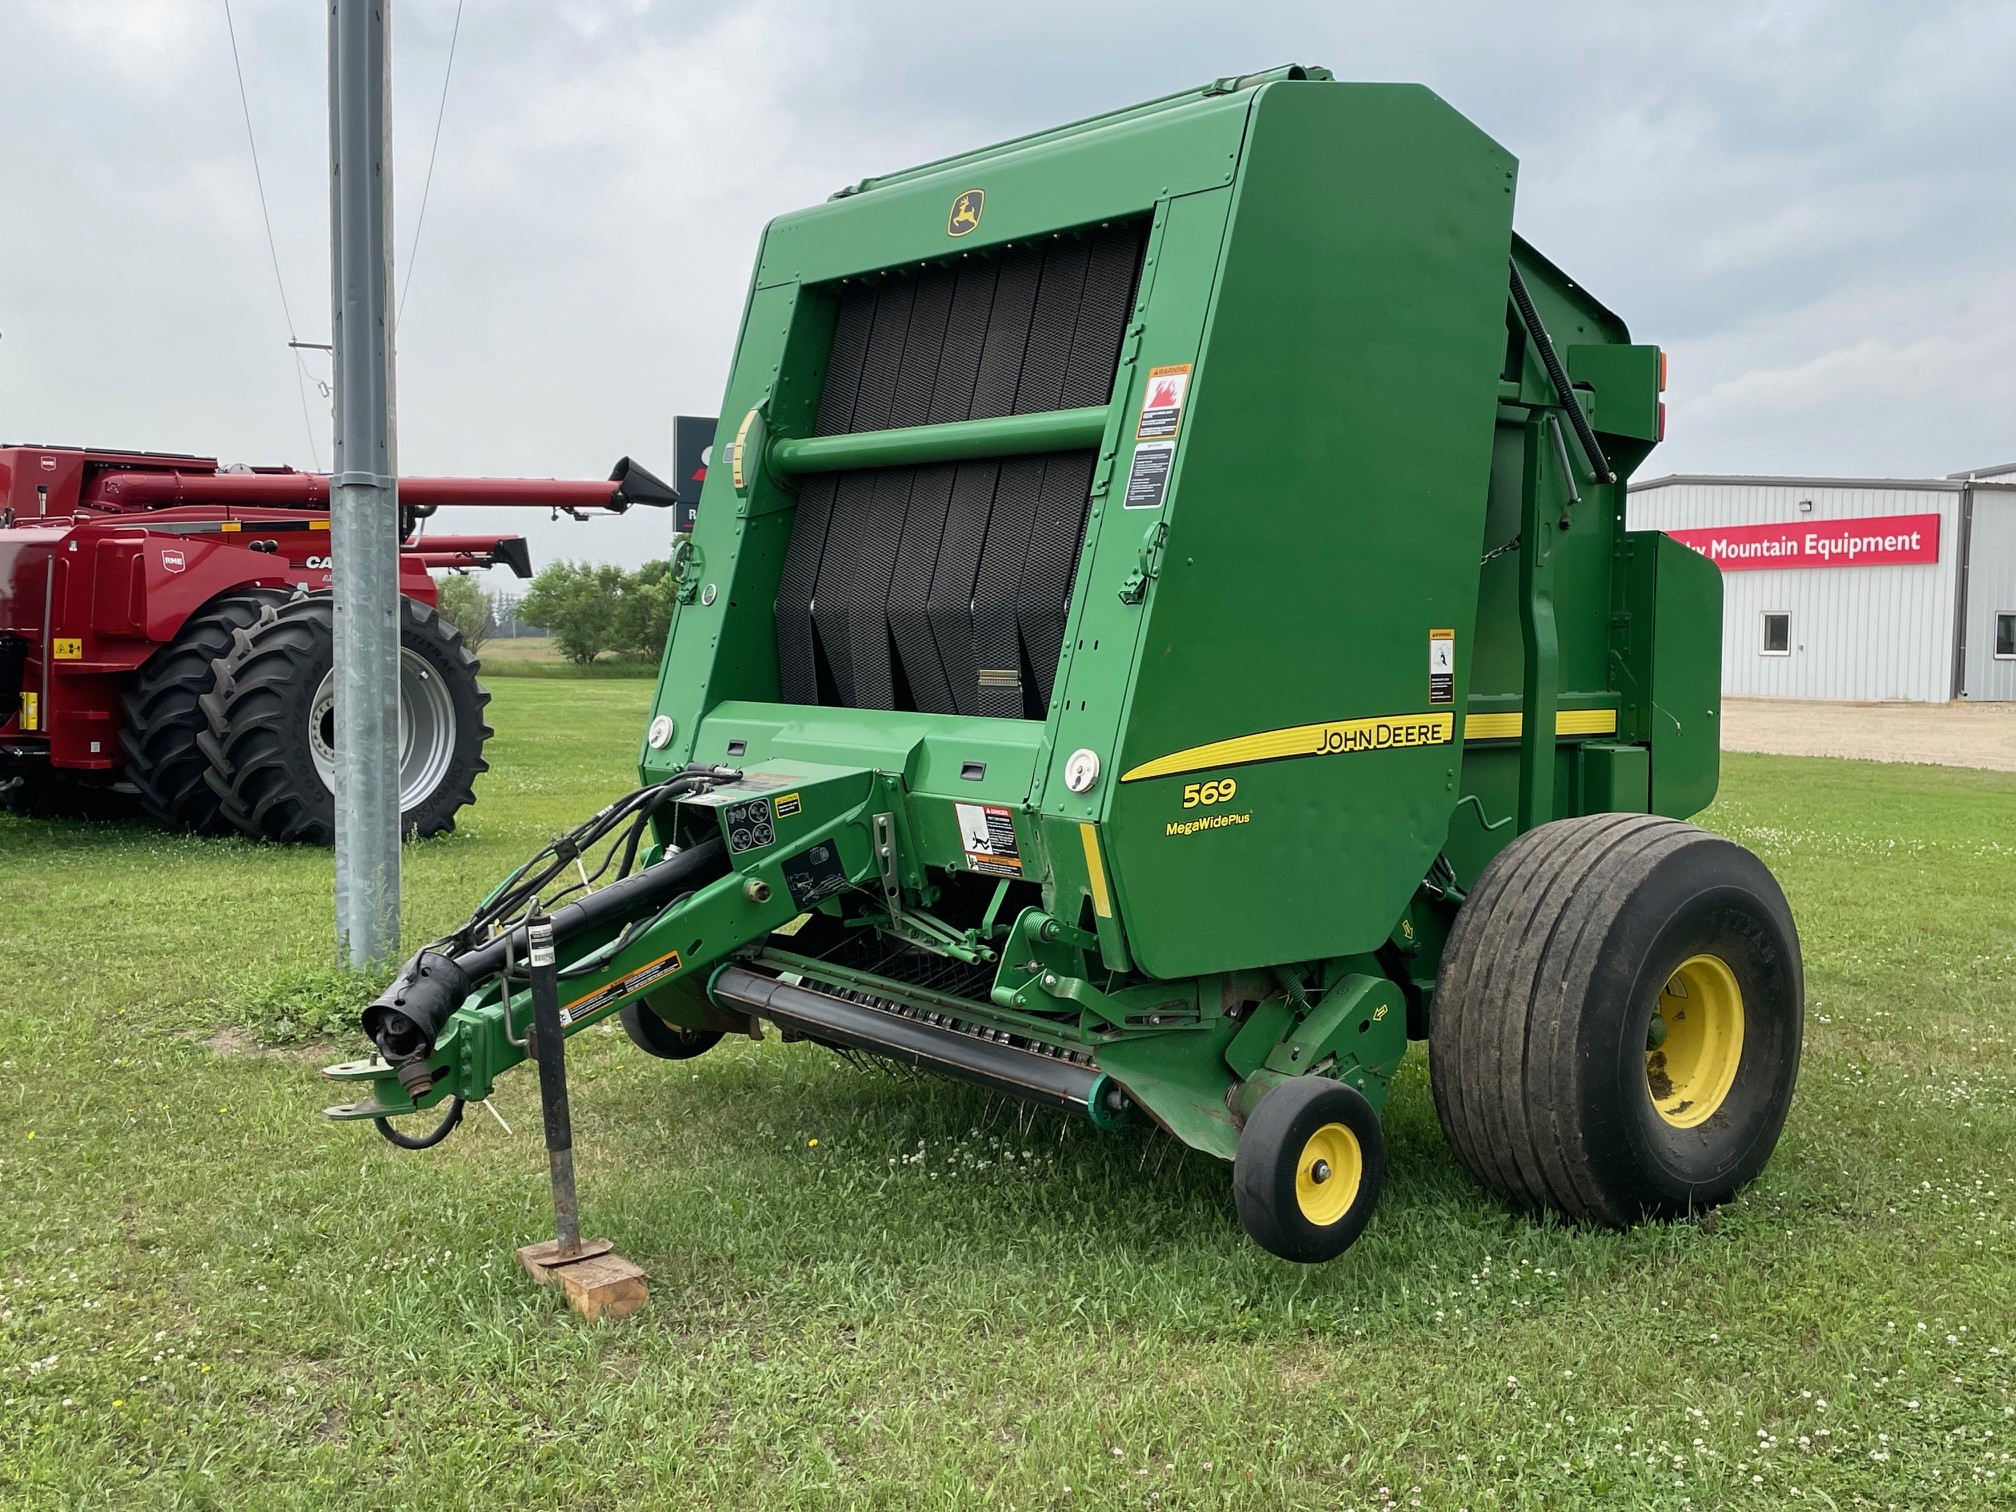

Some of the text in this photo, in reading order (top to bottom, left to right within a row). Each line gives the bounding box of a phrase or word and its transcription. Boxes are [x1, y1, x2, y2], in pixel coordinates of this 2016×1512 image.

[1159, 366, 1188, 375] WARNING
[1711, 535, 1798, 559] Mountain
[1804, 530, 1921, 560] Equipment
[164, 556, 183, 565] RME
[1316, 723, 1443, 752] JOHN DEERE
[1182, 777, 1237, 809] 569
[1165, 813, 1251, 837] MegaWidePlus
